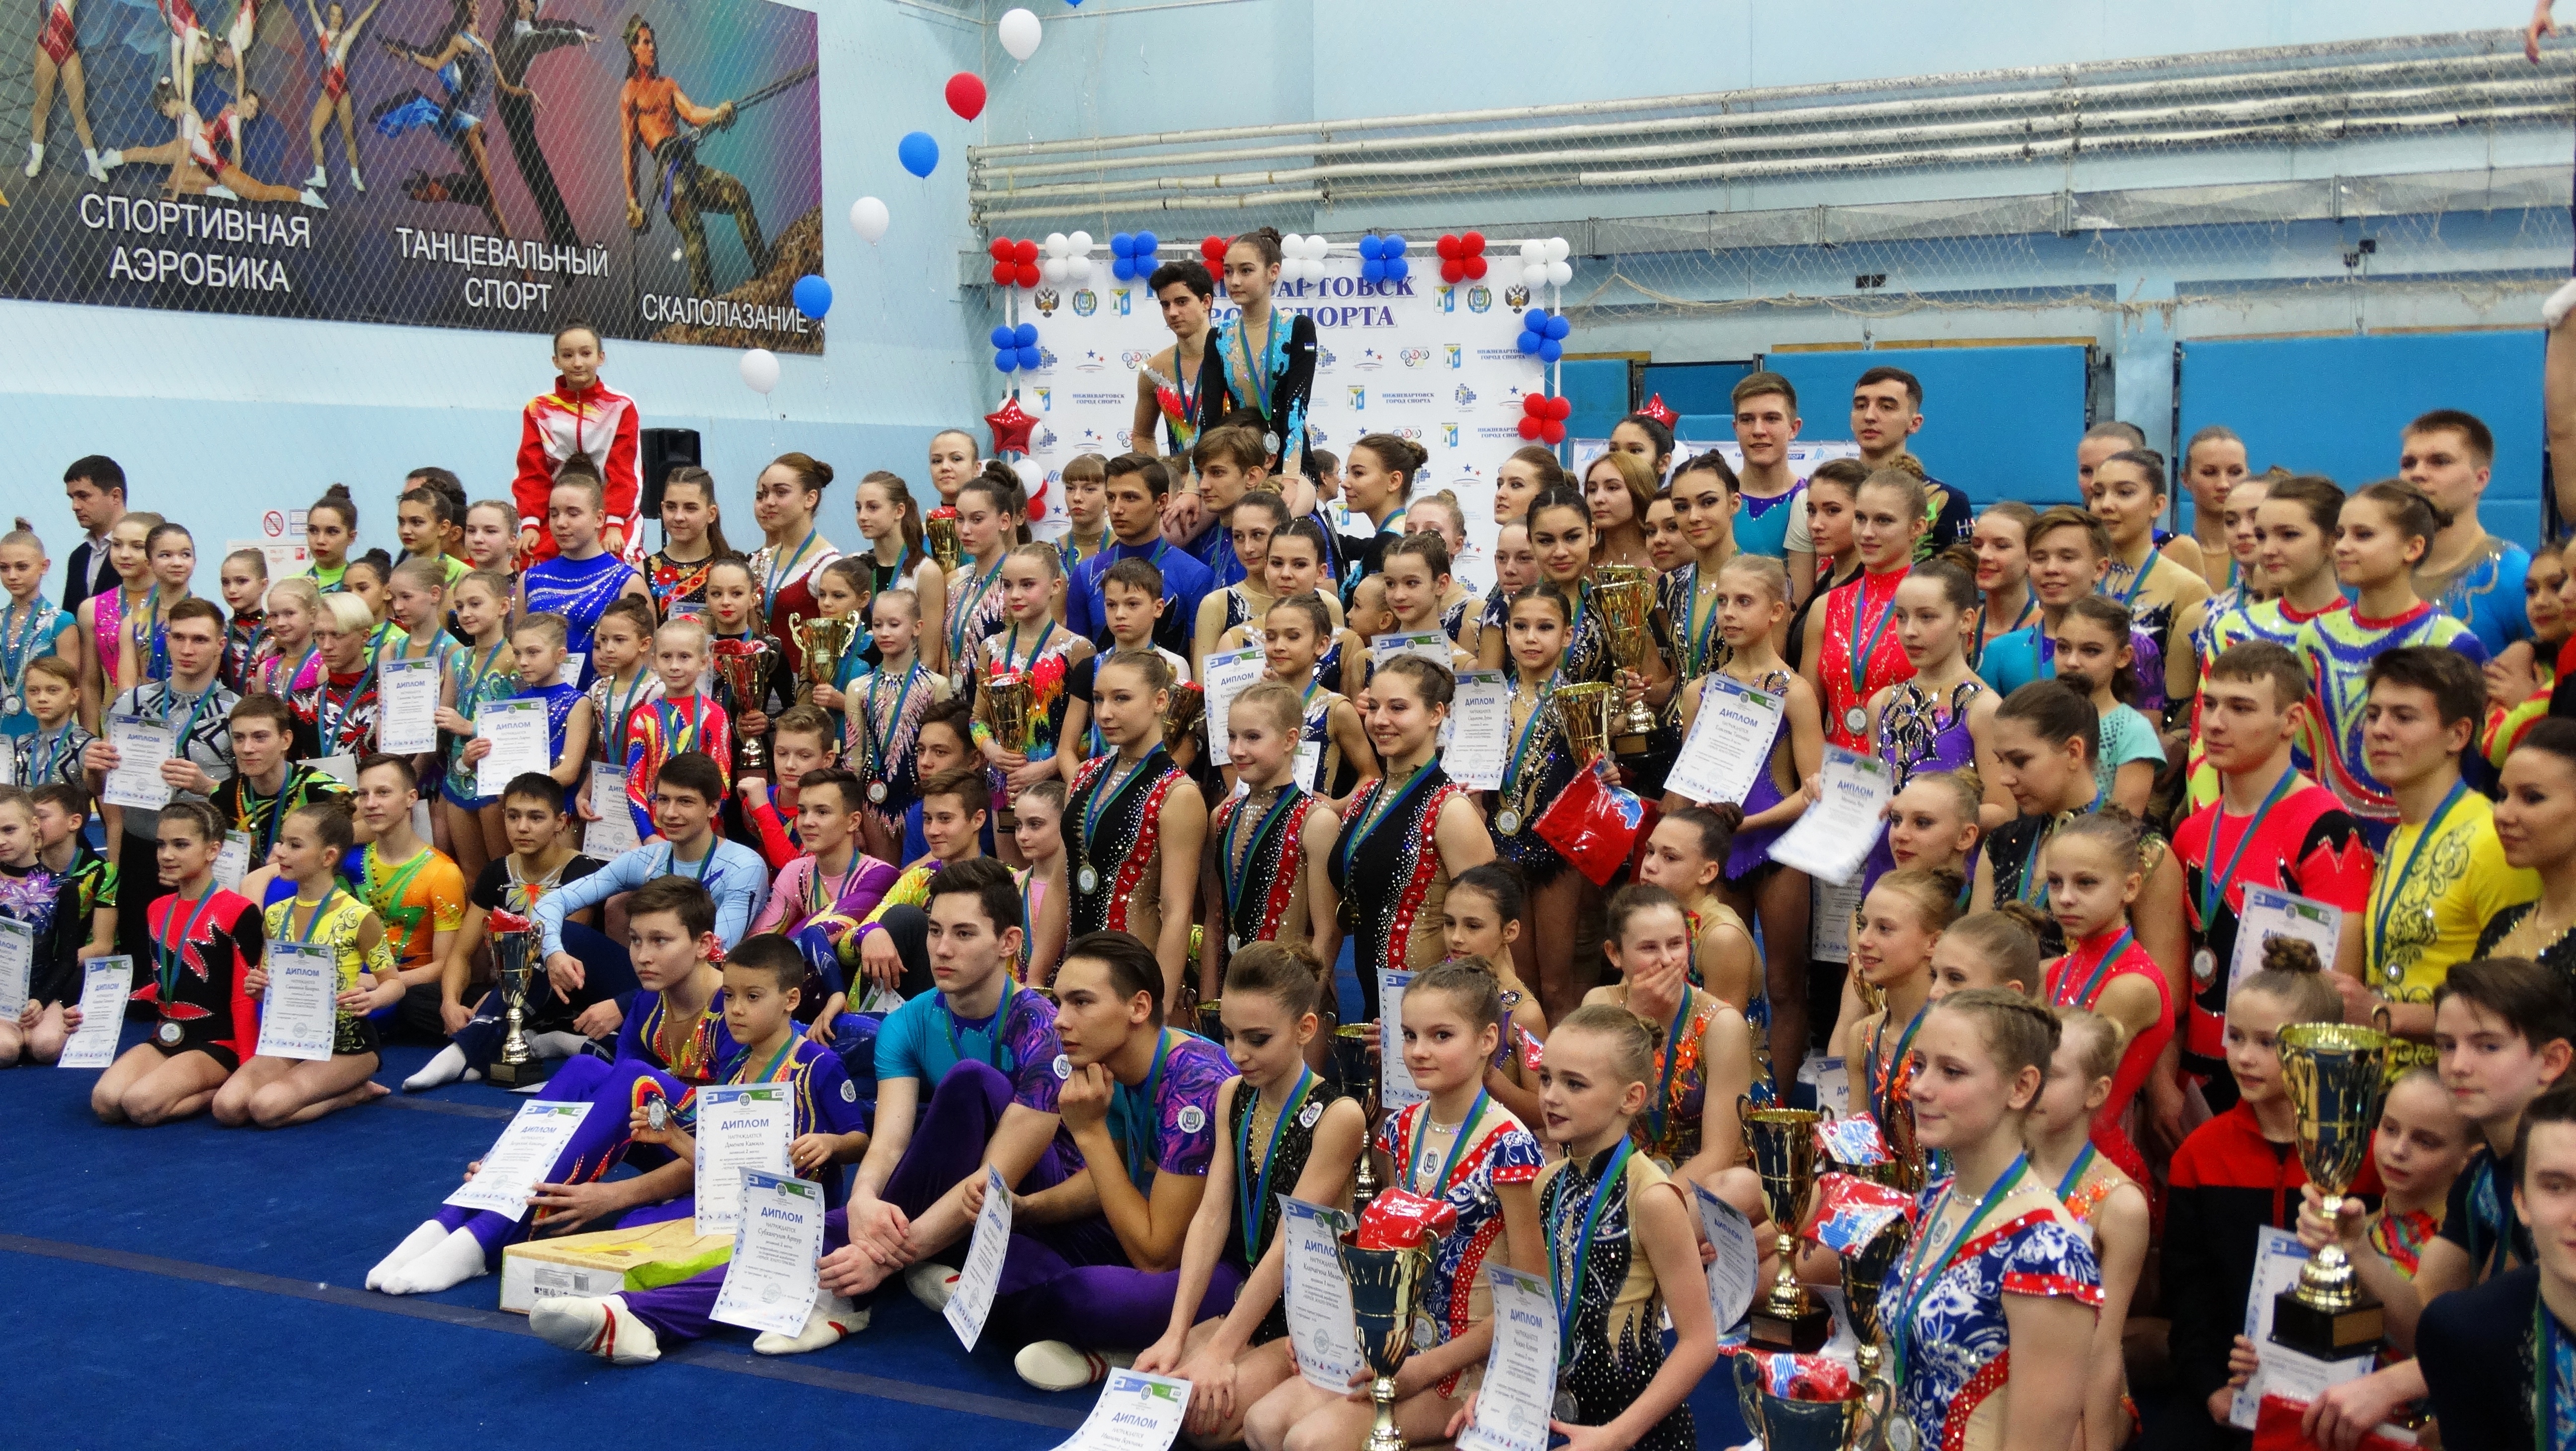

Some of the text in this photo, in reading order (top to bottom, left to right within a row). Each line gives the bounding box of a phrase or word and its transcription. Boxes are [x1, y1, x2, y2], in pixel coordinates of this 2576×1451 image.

[80, 193, 311, 248] СПОРТИВНАЯ
[396, 227, 608, 278] ТАНЦЕВАЛЬНЫЙ
[109, 246, 291, 292] АЭРОБИКА
[465, 277, 552, 312] СПОРТ
[642, 293, 808, 333] СКАЛОЛАЗАНИЕ
[1280, 306, 1395, 326] ПОРТА
[396, 680, 425, 689] ДИПЛОМ
[1221, 672, 1254, 686] ДИПЛОМ
[1465, 697, 1495, 707] ДИПЛОМ
[496, 721, 531, 730] ДИПЛОМ
[1719, 708, 1759, 728] ДИПЛОМ
[127, 733, 161, 743] ДИПЛОМ
[1837, 779, 1874, 799] ДИПЛОМ
[285, 967, 320, 977] ДИПЛОМ
[94, 983, 120, 992] ДИПЛОМ
[721, 1119, 769, 1130] ДИПЛОМ
[761, 1207, 804, 1224] ДИПЛОМ
[1714, 1217, 1743, 1242] ДИПЛОМ
[1304, 1239, 1336, 1258] ДИПЛО
[1510, 1308, 1543, 1329] ДИПЛОМ
[1112, 1412, 1158, 1430] ДИПЛОМ
